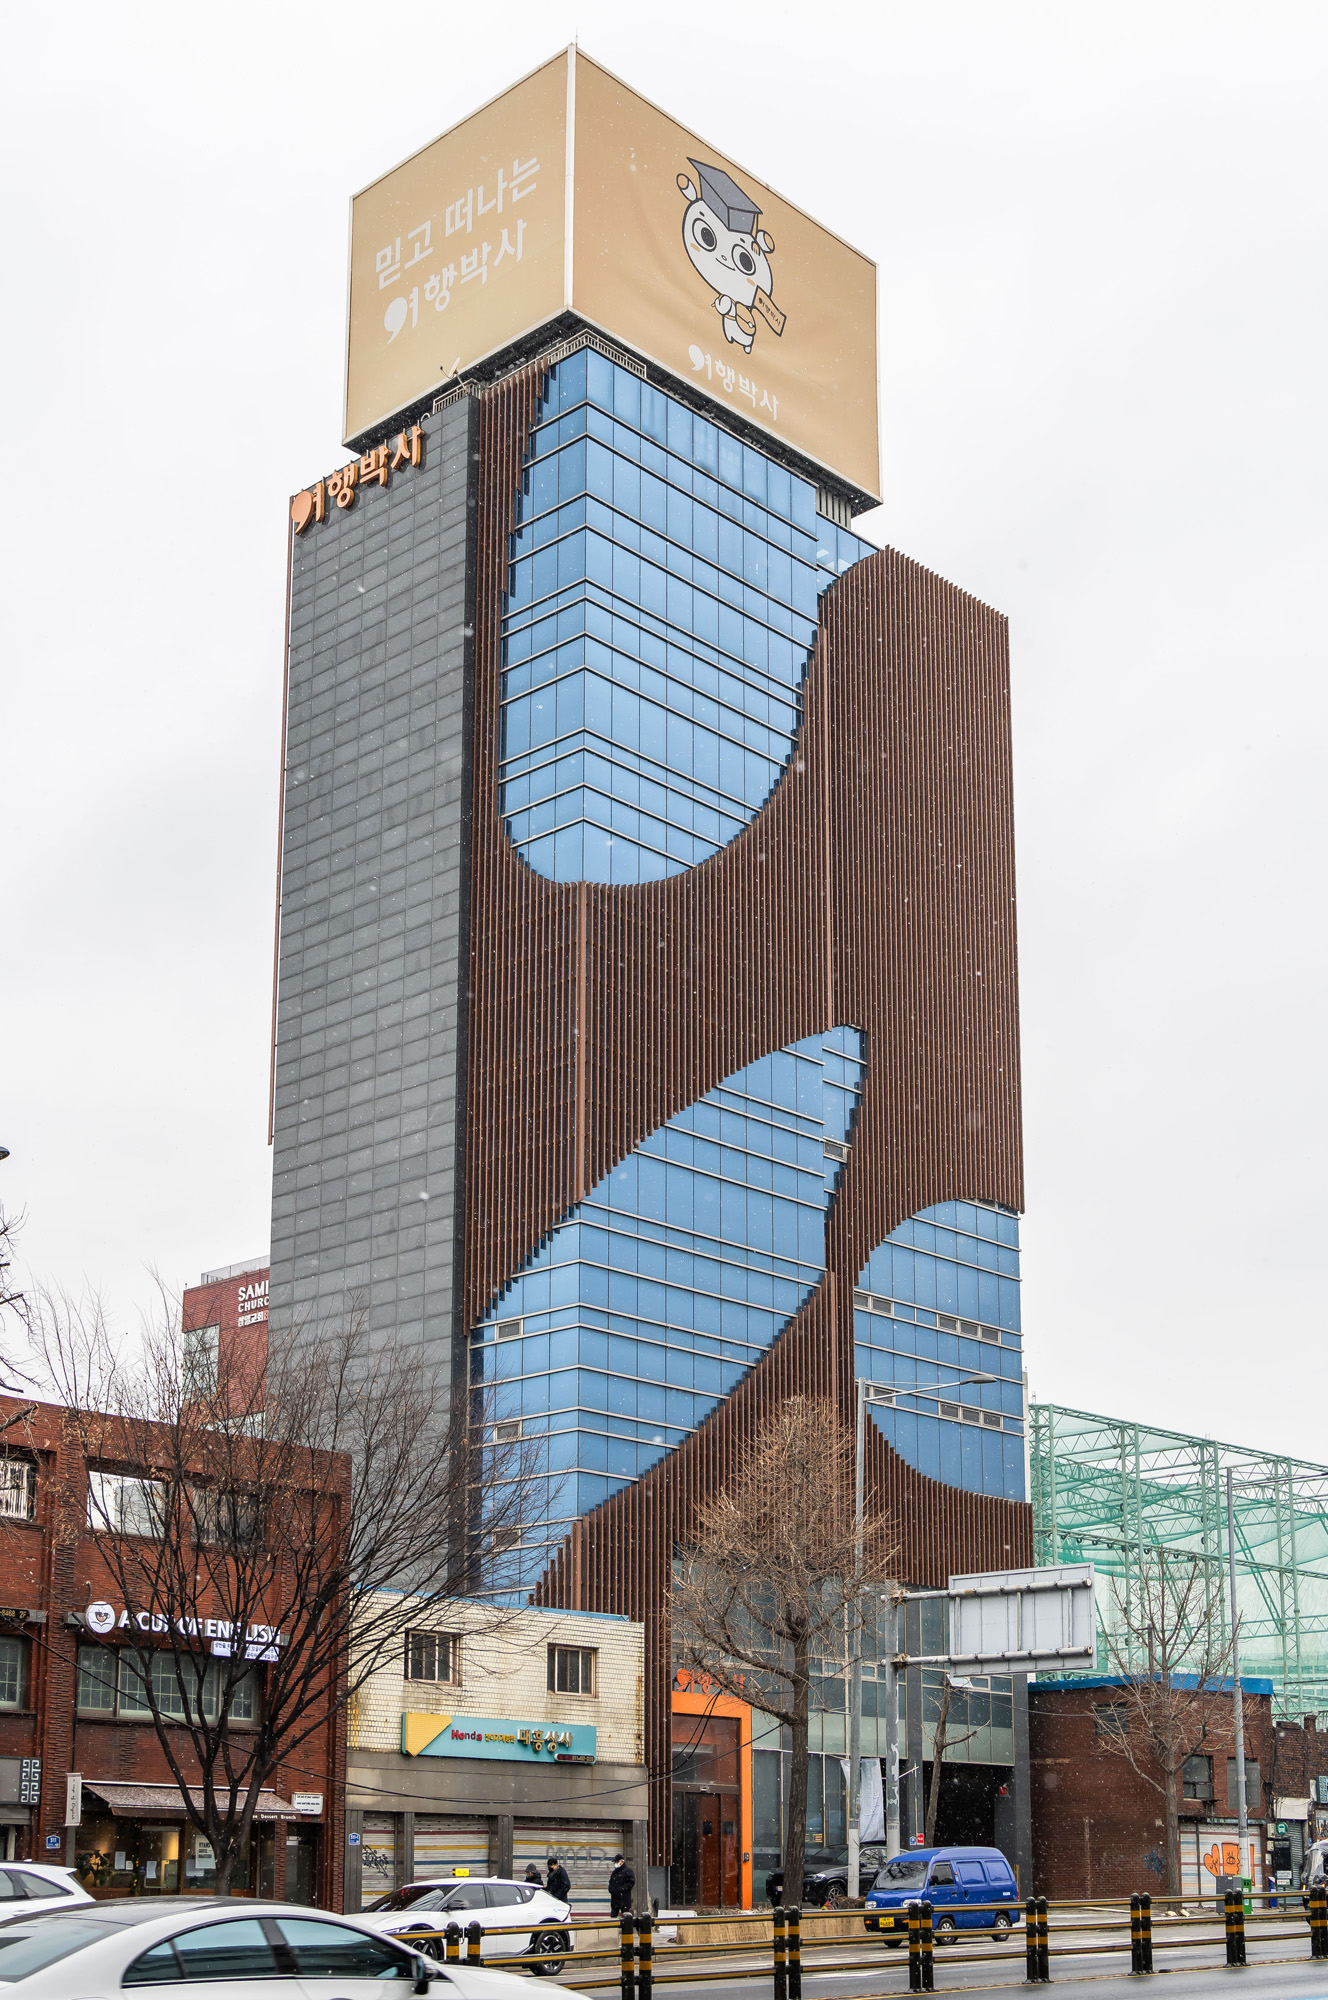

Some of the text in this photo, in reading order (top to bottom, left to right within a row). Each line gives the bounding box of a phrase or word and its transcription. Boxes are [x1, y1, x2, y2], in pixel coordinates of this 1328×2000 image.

[376, 157, 540, 291] 믿고 떠나는
[384, 218, 527, 345] 여행박사
[688, 344, 779, 421] 여행박사
[291, 425, 425, 536] 여행박사
[117, 1609, 132, 1628] A
[205, 1619, 281, 1645] ENGLISH
[451, 1729, 483, 1741] Honda
[517, 1729, 573, 1752] 대흥상사
